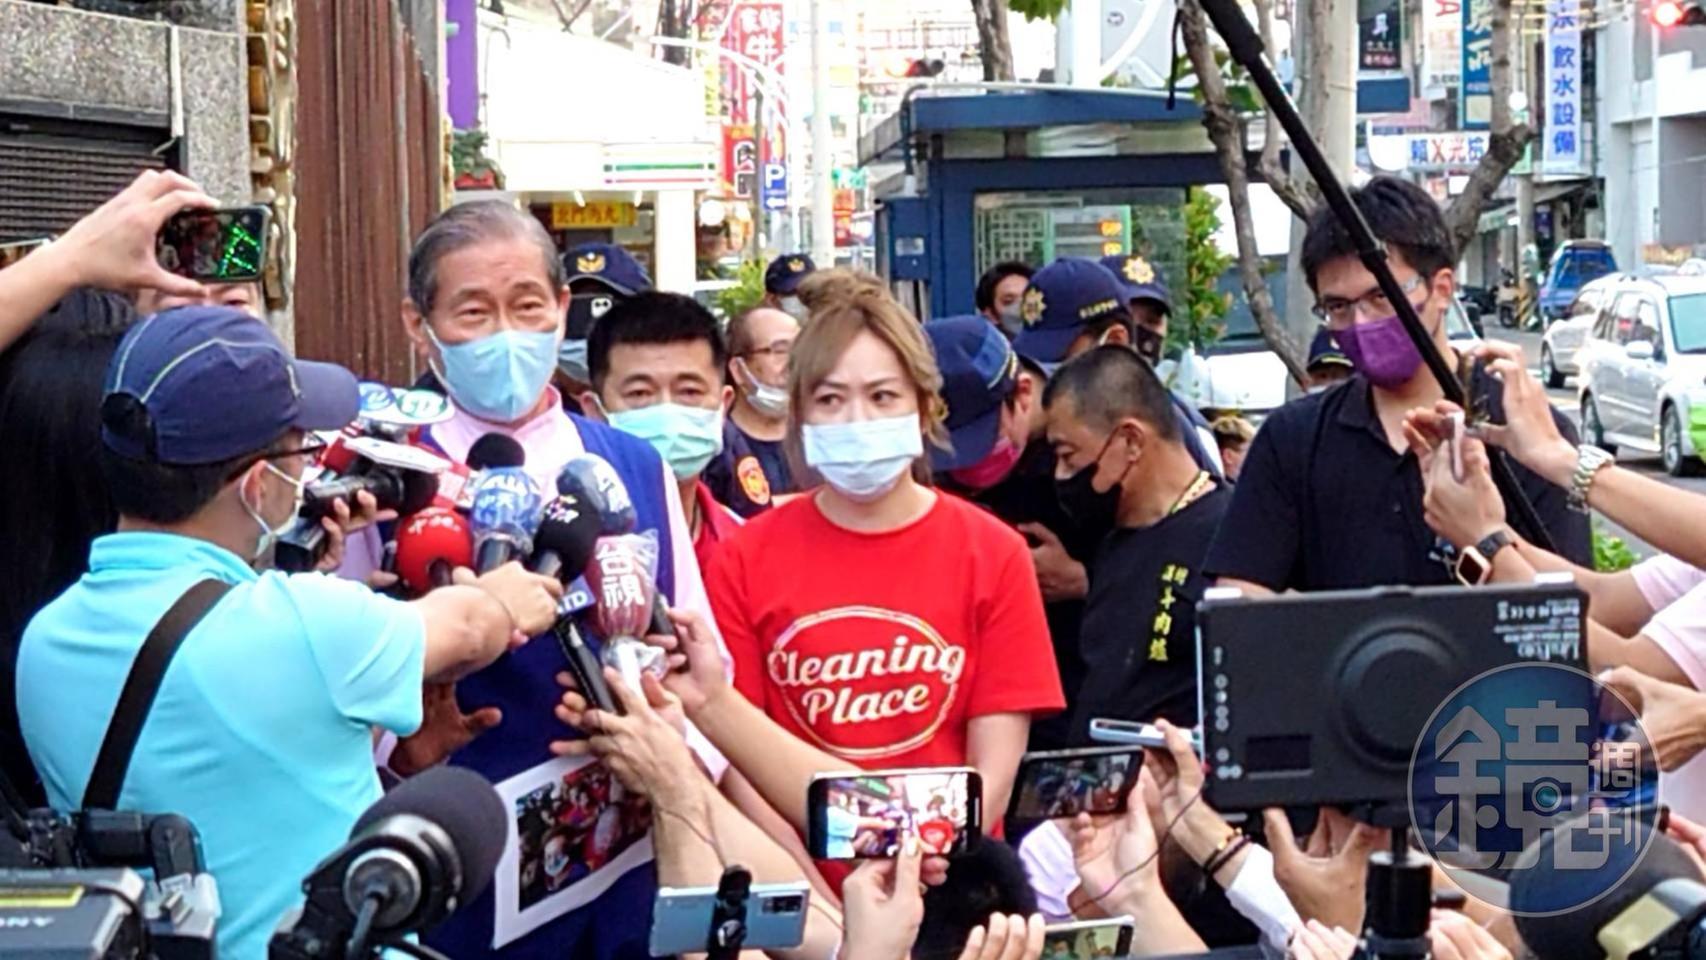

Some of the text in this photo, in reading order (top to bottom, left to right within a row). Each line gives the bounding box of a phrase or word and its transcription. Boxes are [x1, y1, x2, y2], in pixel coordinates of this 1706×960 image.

[1553, 45, 1575, 154] 飲水設備
[764, 163, 785, 189] P
[595, 542, 646, 609] 台視
[767, 635, 966, 687] Cleaning
[802, 684, 932, 726] Place
